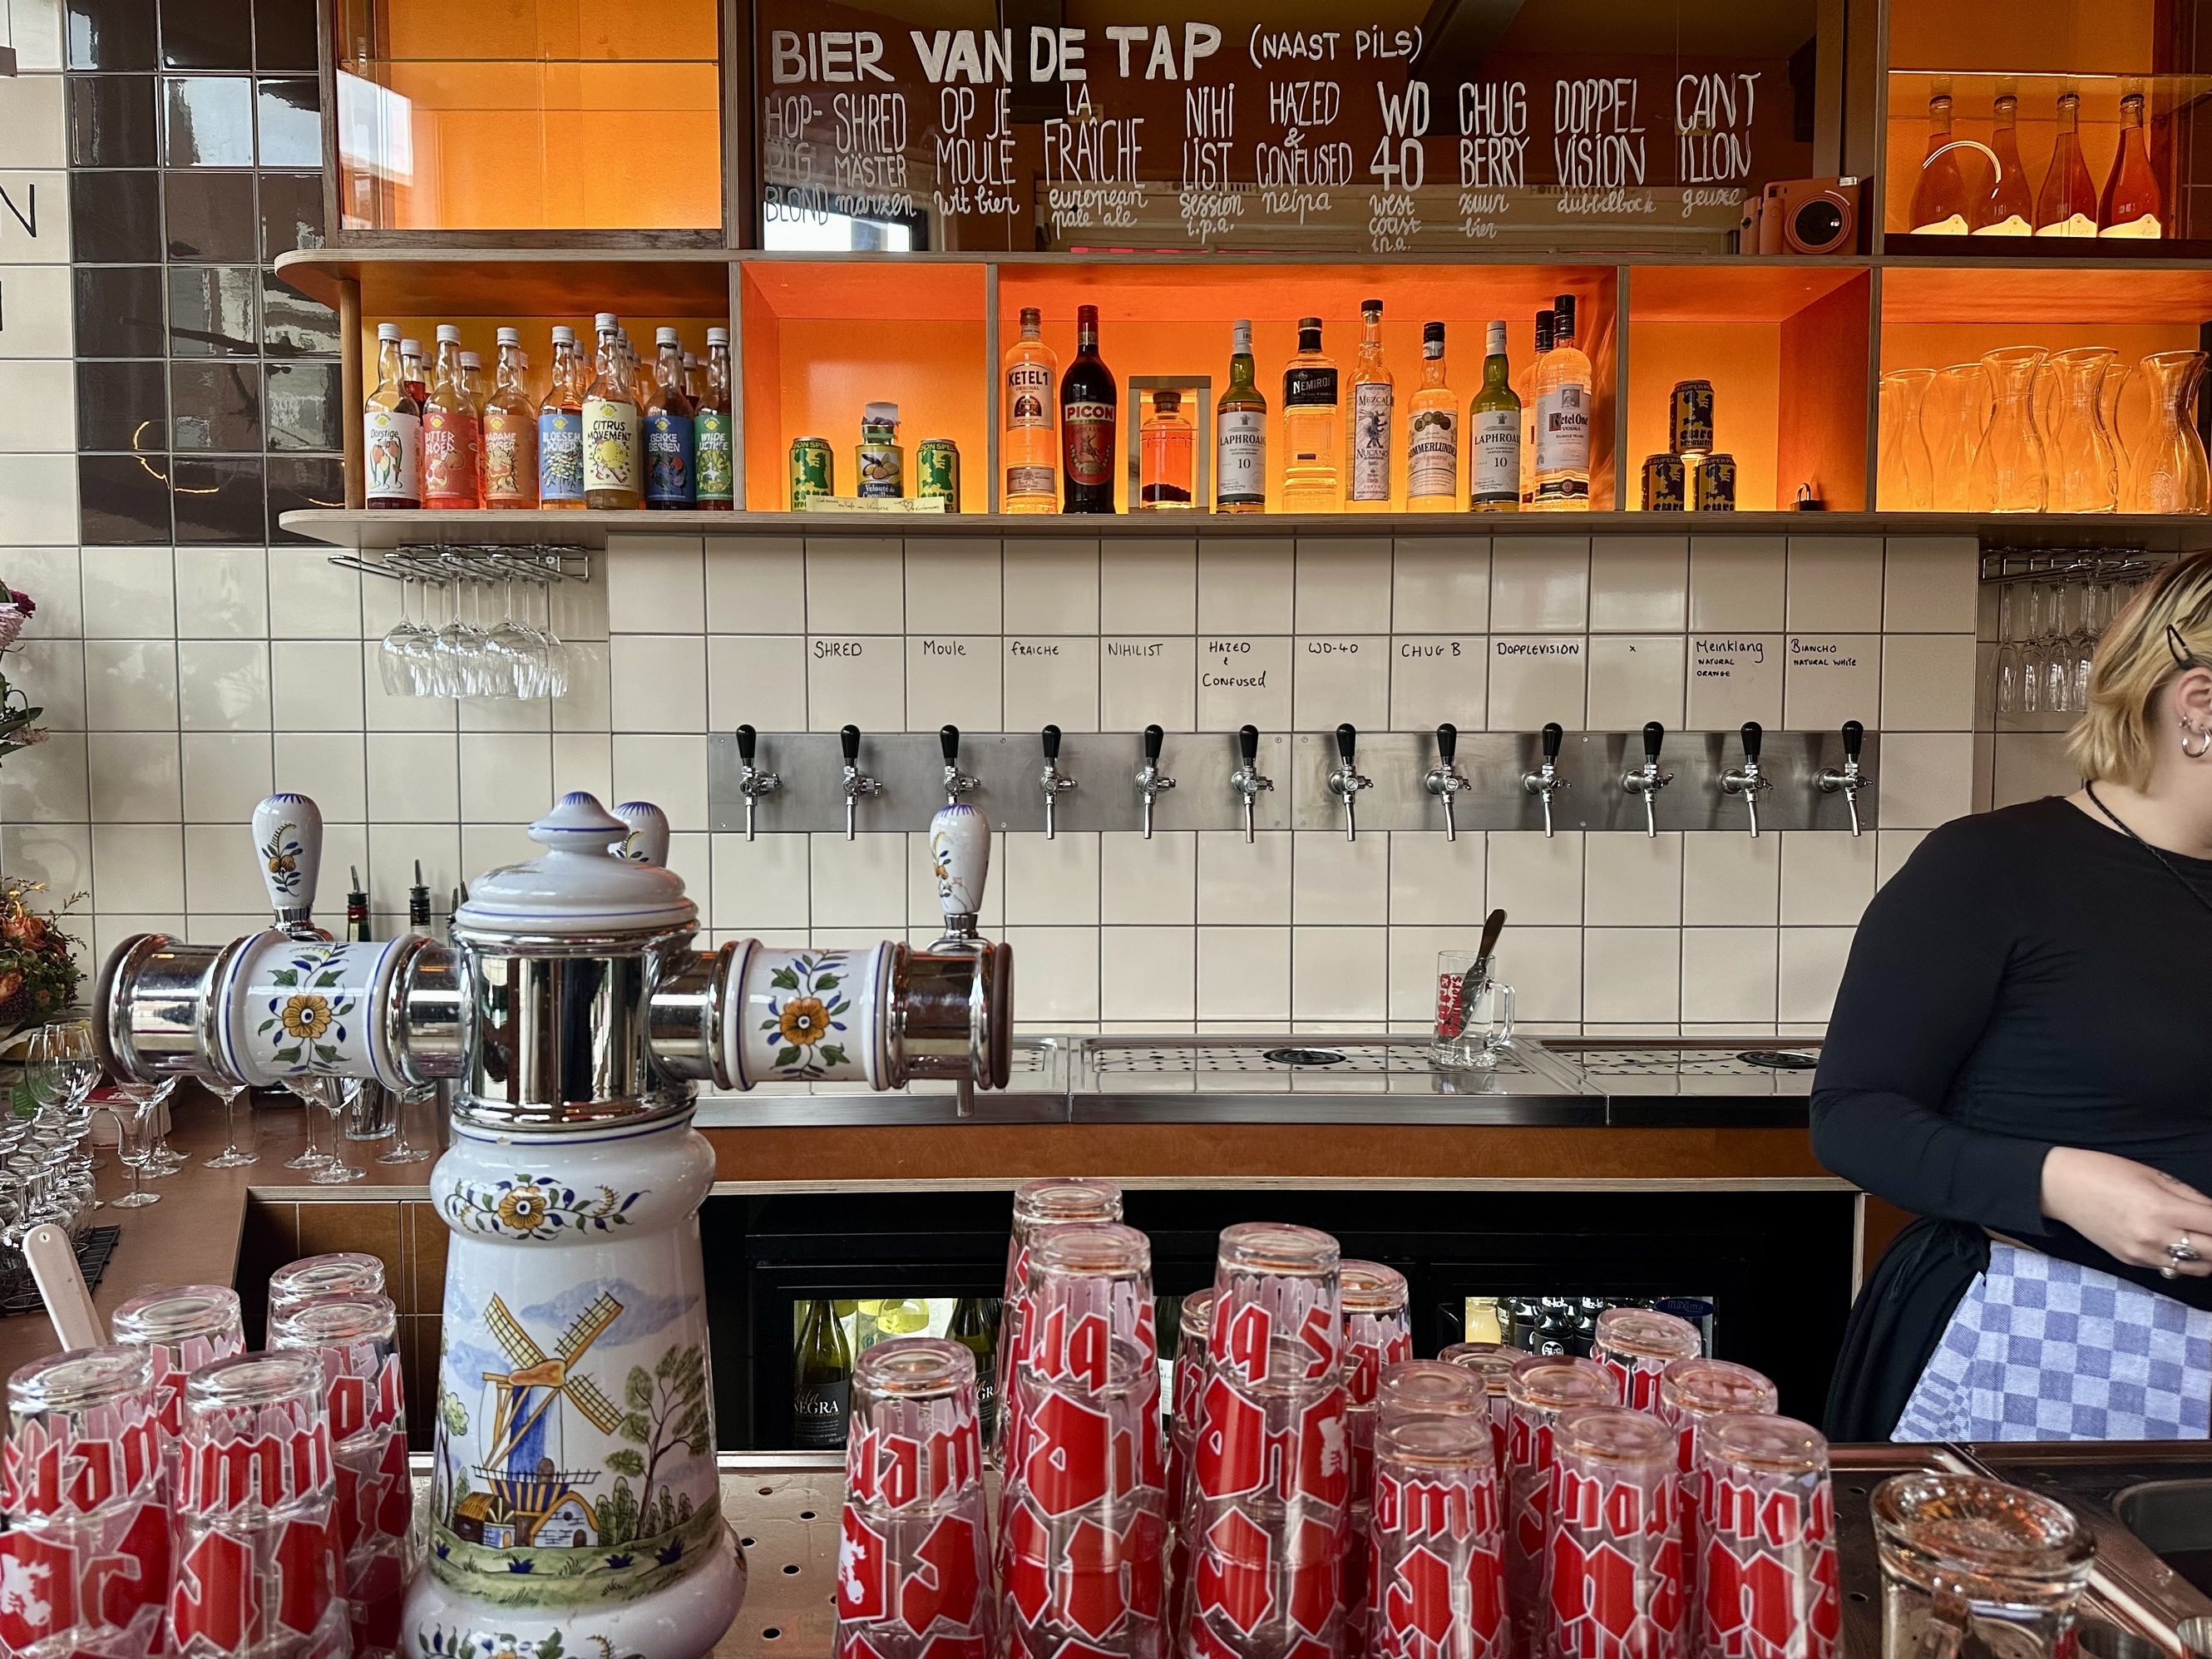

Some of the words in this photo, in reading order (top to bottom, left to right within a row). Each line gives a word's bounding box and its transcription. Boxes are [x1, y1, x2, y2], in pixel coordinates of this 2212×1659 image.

[772, 30, 896, 83] BIER
[910, 28, 1013, 83] VAN
[1030, 26, 1086, 81] DE
[1106, 22, 1222, 81] TAP
[1250, 24, 1340, 68] (NAAST
[1066, 82, 1092, 116] LA
[1186, 83, 1235, 138] NIHI
[1270, 81, 1340, 126] HAZED
[1377, 80, 1429, 137] WD
[1459, 81, 1527, 136] CHUG
[1555, 78, 1646, 134] DOPPEL
[1676, 72, 1761, 131] CANT
[765, 96, 822, 140] HOP-
[833, 93, 907, 155] SHRED
[941, 86, 975, 134] OP
[986, 88, 1012, 141] JE
[1284, 127, 1305, 148] &
[936, 136, 1016, 185] MOULE
[1044, 118, 1146, 189] FRAÎCHE
[1183, 137, 1233, 192] LIST
[1256, 142, 1353, 189] CONFUSED
[1370, 136, 1424, 192] 40
[1459, 136, 1530, 190] BERRY
[1554, 133, 1646, 190] VISION
[1681, 130, 1751, 183] ILLON
[764, 183, 829, 226] BLOND
[835, 192, 917, 217] marzen
[975, 185, 1020, 216] bier
[1049, 188, 1148, 218] european
[1178, 191, 1245, 218] session
[1262, 189, 1332, 225] neipa
[1369, 193, 1415, 216] west
[1681, 188, 1741, 219] geuze
[1051, 205, 1094, 239] pale
[1104, 208, 1138, 228] ale
[1368, 217, 1422, 236] coast
[1068, 406, 1113, 419] PICON
[1359, 395, 1390, 406] MEZCAL
[594, 420, 625, 431] CITRUS
[1576, 414, 1587, 425] One
[371, 428, 399, 440] Dorstige
[425, 431, 455, 442] BITTER
[543, 432, 580, 442] BLOESEM
[587, 431, 631, 442] MOVEMENT
[650, 433, 677, 442] GEKKE
[701, 432, 725, 442] WILDE
[547, 442, 576, 452] POWER
[1356, 449, 1388, 459] NUCANO
[1238, 458, 1251, 469] 10
[1494, 457, 1508, 467] 10
[865, 484, 889, 492] Velouté
[813, 641, 862, 659] SHRED
[923, 640, 966, 655] Moule
[1108, 643, 1163, 656] NIHILIST
[1308, 643, 1359, 654] WD-40
[1401, 644, 1444, 658] CHUG
[1451, 642, 1461, 656] B
[1497, 642, 1579, 655] DOPPLEVISION
[1696, 639, 1764, 664] Meinklang
[1790, 638, 1837, 654] BIANCHO
